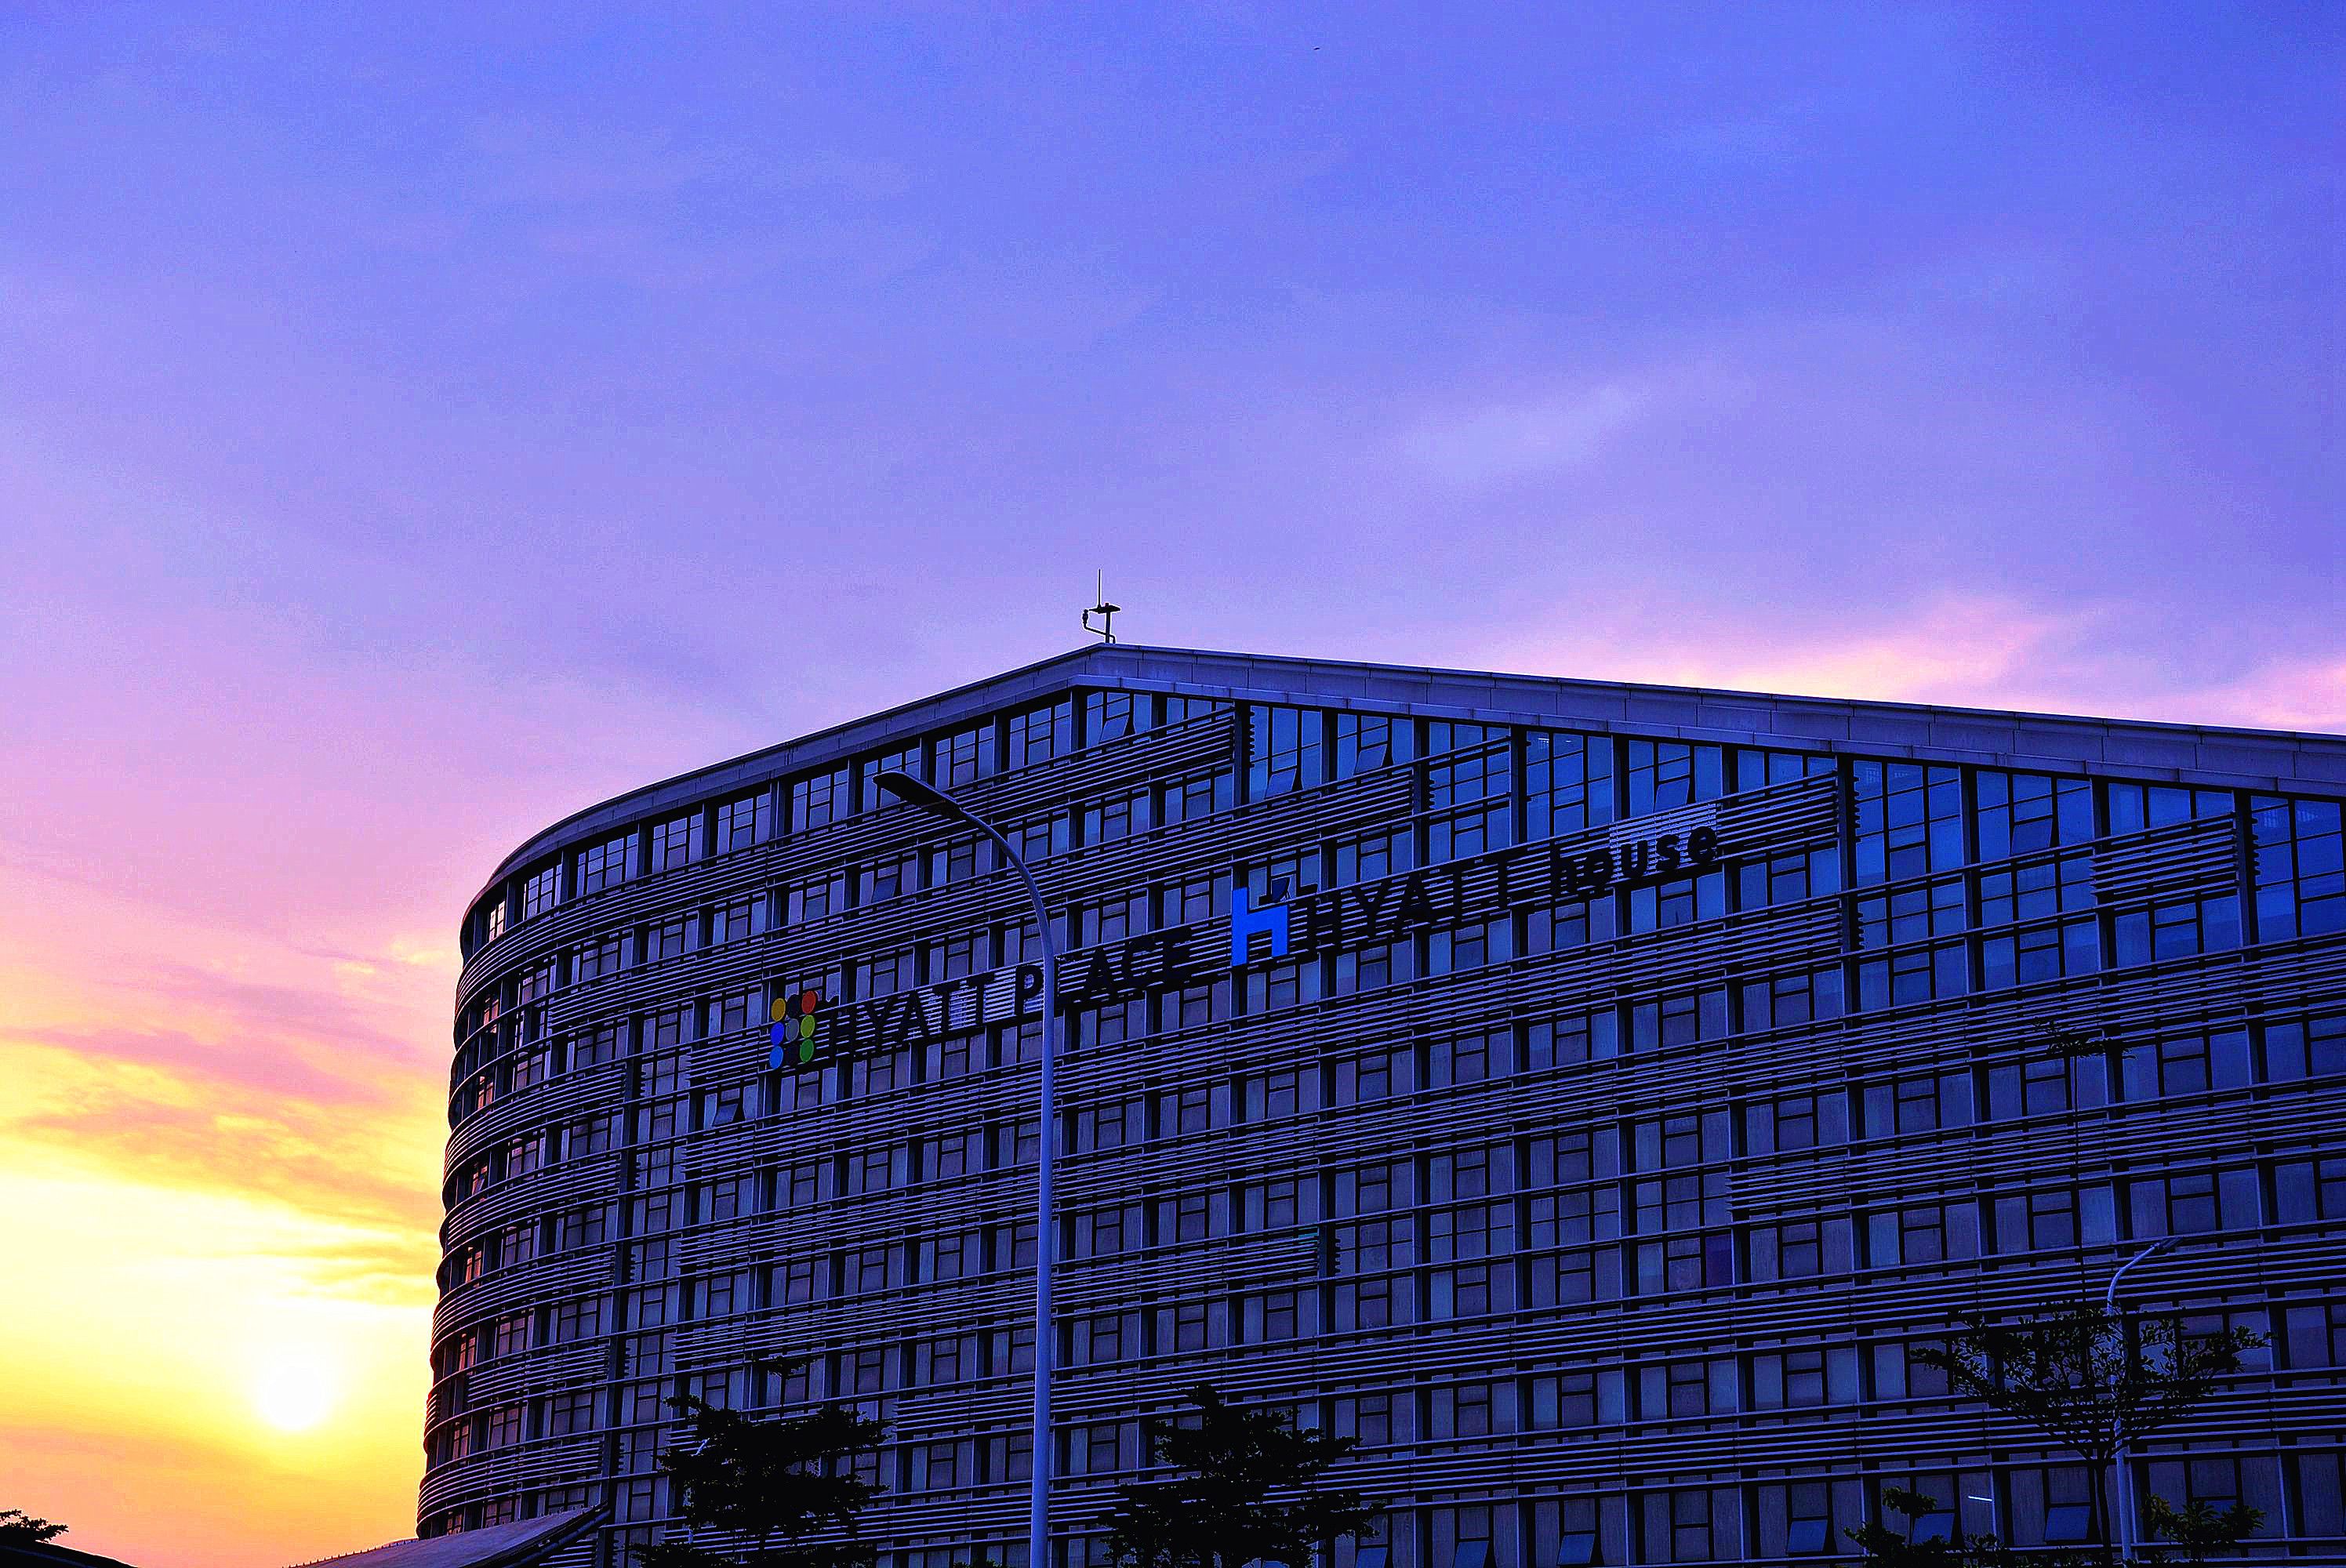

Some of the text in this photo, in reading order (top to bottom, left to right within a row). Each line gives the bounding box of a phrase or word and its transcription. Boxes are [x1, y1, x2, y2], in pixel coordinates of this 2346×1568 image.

[1306, 848, 1519, 956] HYATT
[1549, 826, 1717, 895] house
[828, 972, 994, 1057] HYATT
